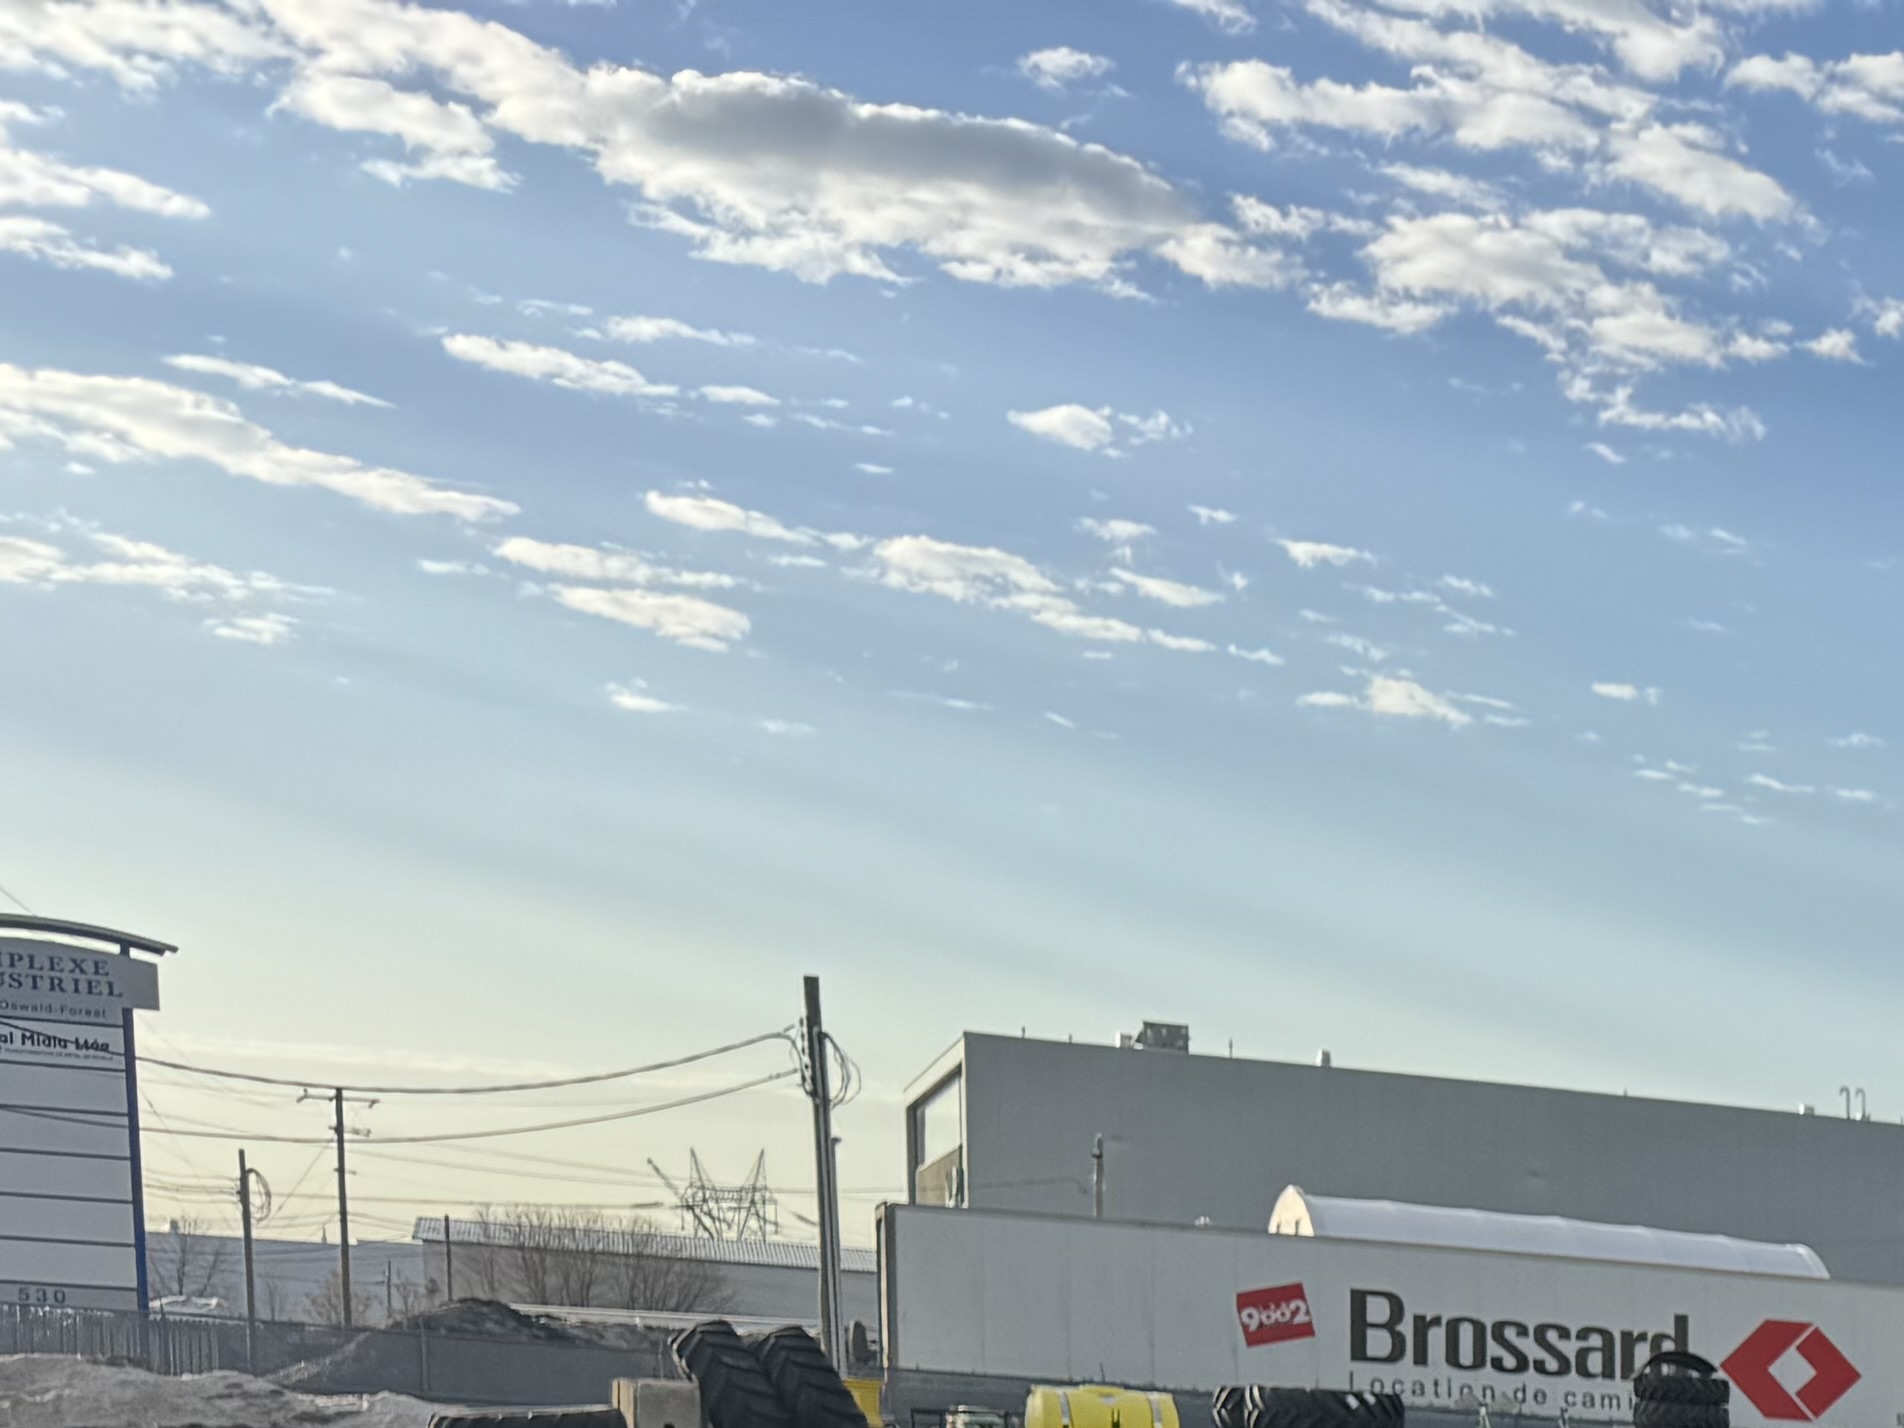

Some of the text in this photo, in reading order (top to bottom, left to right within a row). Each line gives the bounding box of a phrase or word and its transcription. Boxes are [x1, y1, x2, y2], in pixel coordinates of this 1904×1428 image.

[0, 950, 110, 977] PLEXE
[18, 1287, 66, 1304] 530
[1513, 1382, 1546, 1406] de
[1564, 1388, 1633, 1412] cami
